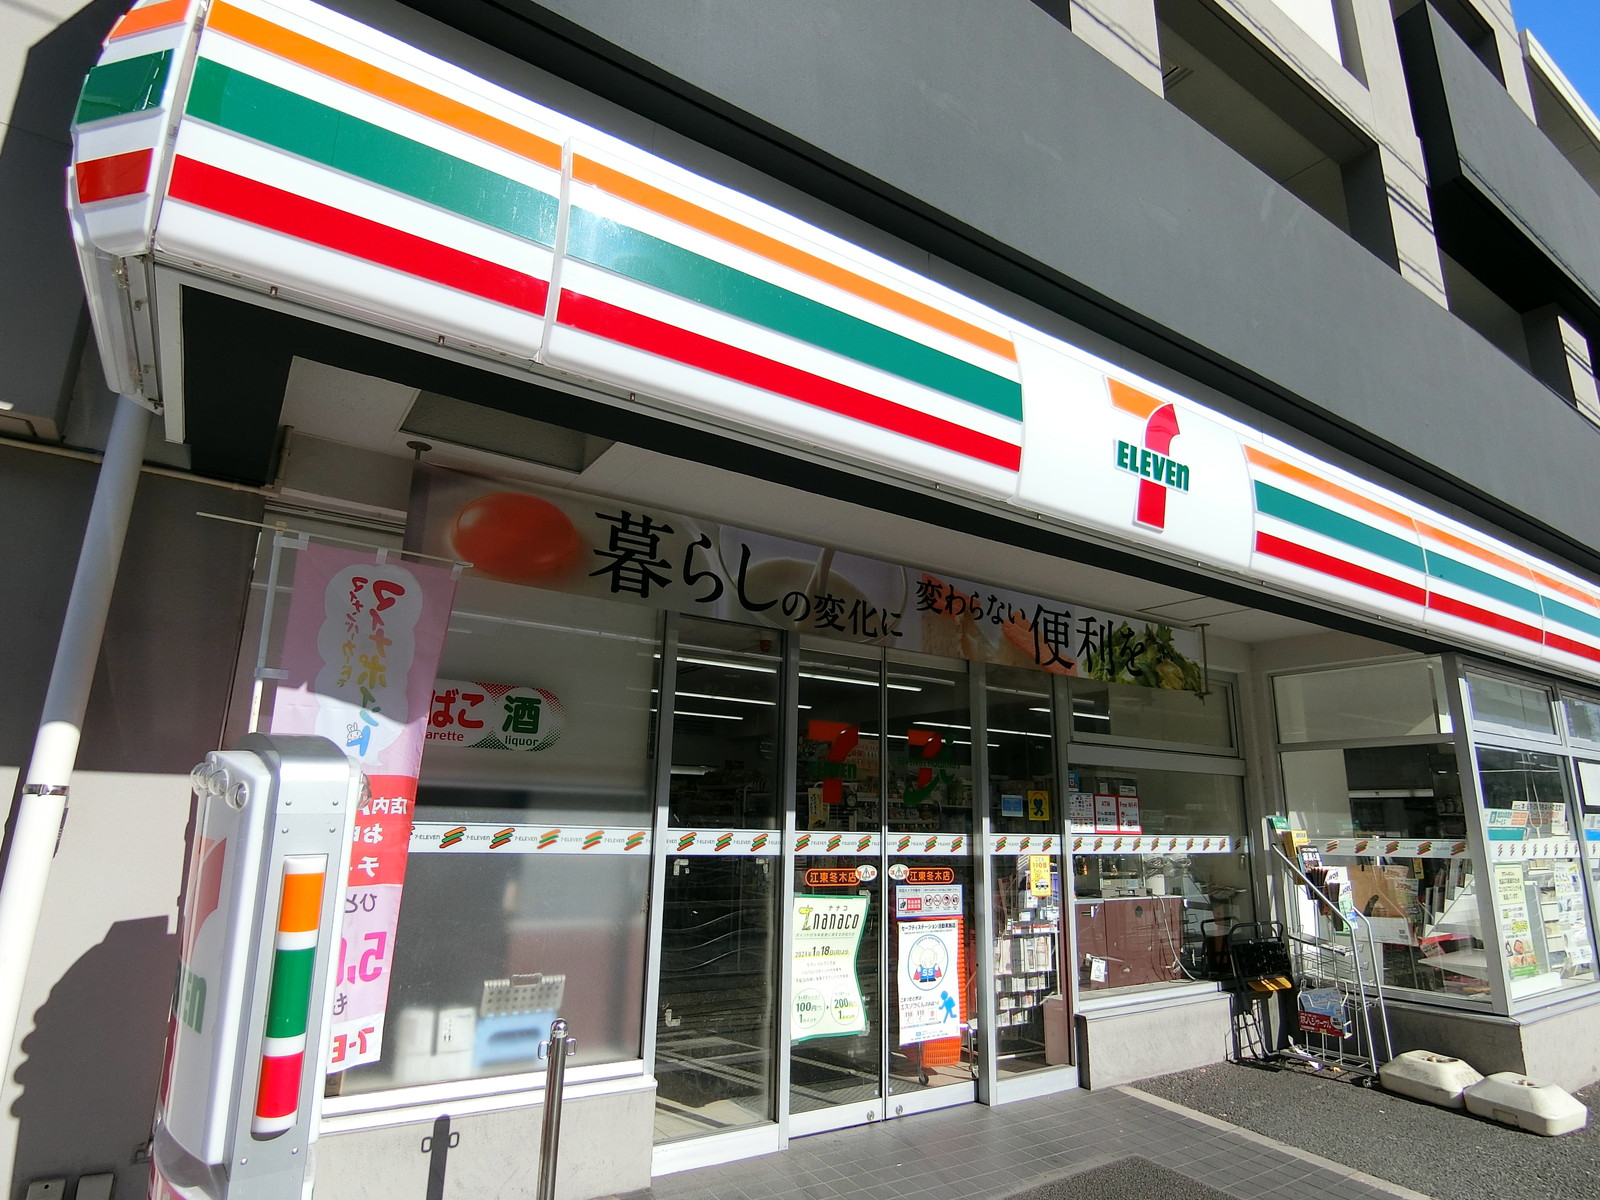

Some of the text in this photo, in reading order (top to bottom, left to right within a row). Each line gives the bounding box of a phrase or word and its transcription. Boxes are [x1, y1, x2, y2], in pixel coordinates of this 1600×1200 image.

[589, 510, 903, 638] 暮らしの変化に
[916, 579, 1146, 676] 変わらない便利を
[502, 695, 542, 734] 酒
[505, 736, 539, 747] liquor
[809, 872, 857, 883] 江東冬木店
[909, 871, 950, 881] 江東冬木店
[813, 913, 860, 930] nanaco
